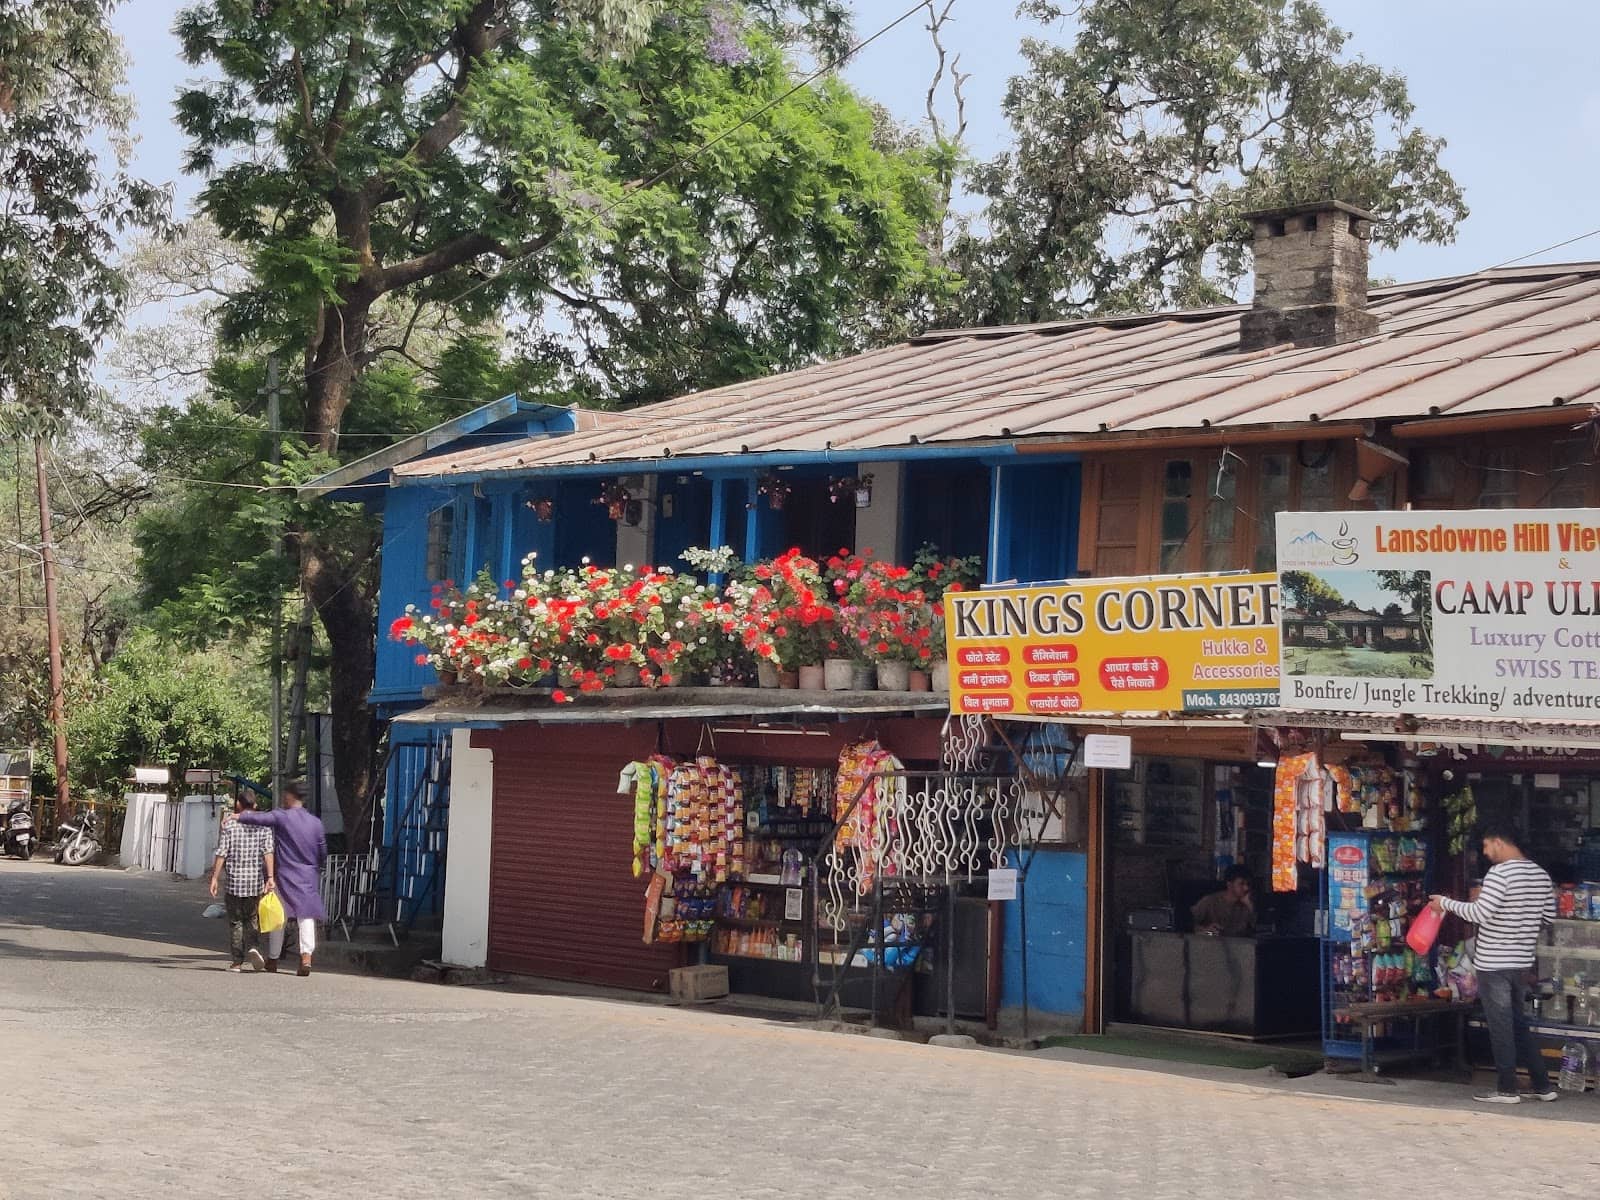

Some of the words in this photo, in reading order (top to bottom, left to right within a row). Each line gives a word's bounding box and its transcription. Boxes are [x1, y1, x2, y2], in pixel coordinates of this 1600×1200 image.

[1376, 524, 1506, 553] Lansdowne
[1513, 523, 1549, 552] Hill
[1558, 557, 1572, 569] &
[1435, 580, 1534, 615] CAMP
[955, 594, 1083, 637] KINGS
[1202, 640, 1249, 655] Hukka
[1255, 638, 1267, 654] &
[1470, 626, 1546, 652] Luxury
[965, 651, 983, 663] फोटो
[985, 651, 1001, 663] स्टेट
[1132, 659, 1149, 672] कार्ड
[1150, 659, 1159, 671] से
[1194, 663, 1280, 679] Accessories
[1496, 659, 1562, 678] SWISS
[1569, 660, 1600, 679] TE
[1060, 696, 1079, 709] फोटो
[1185, 693, 1216, 707] Mob.
[1294, 679, 1358, 701] Bonfire/
[1363, 682, 1416, 708] Jungle
[1422, 684, 1506, 711] Trekking/
[1513, 687, 1600, 709] adventure
